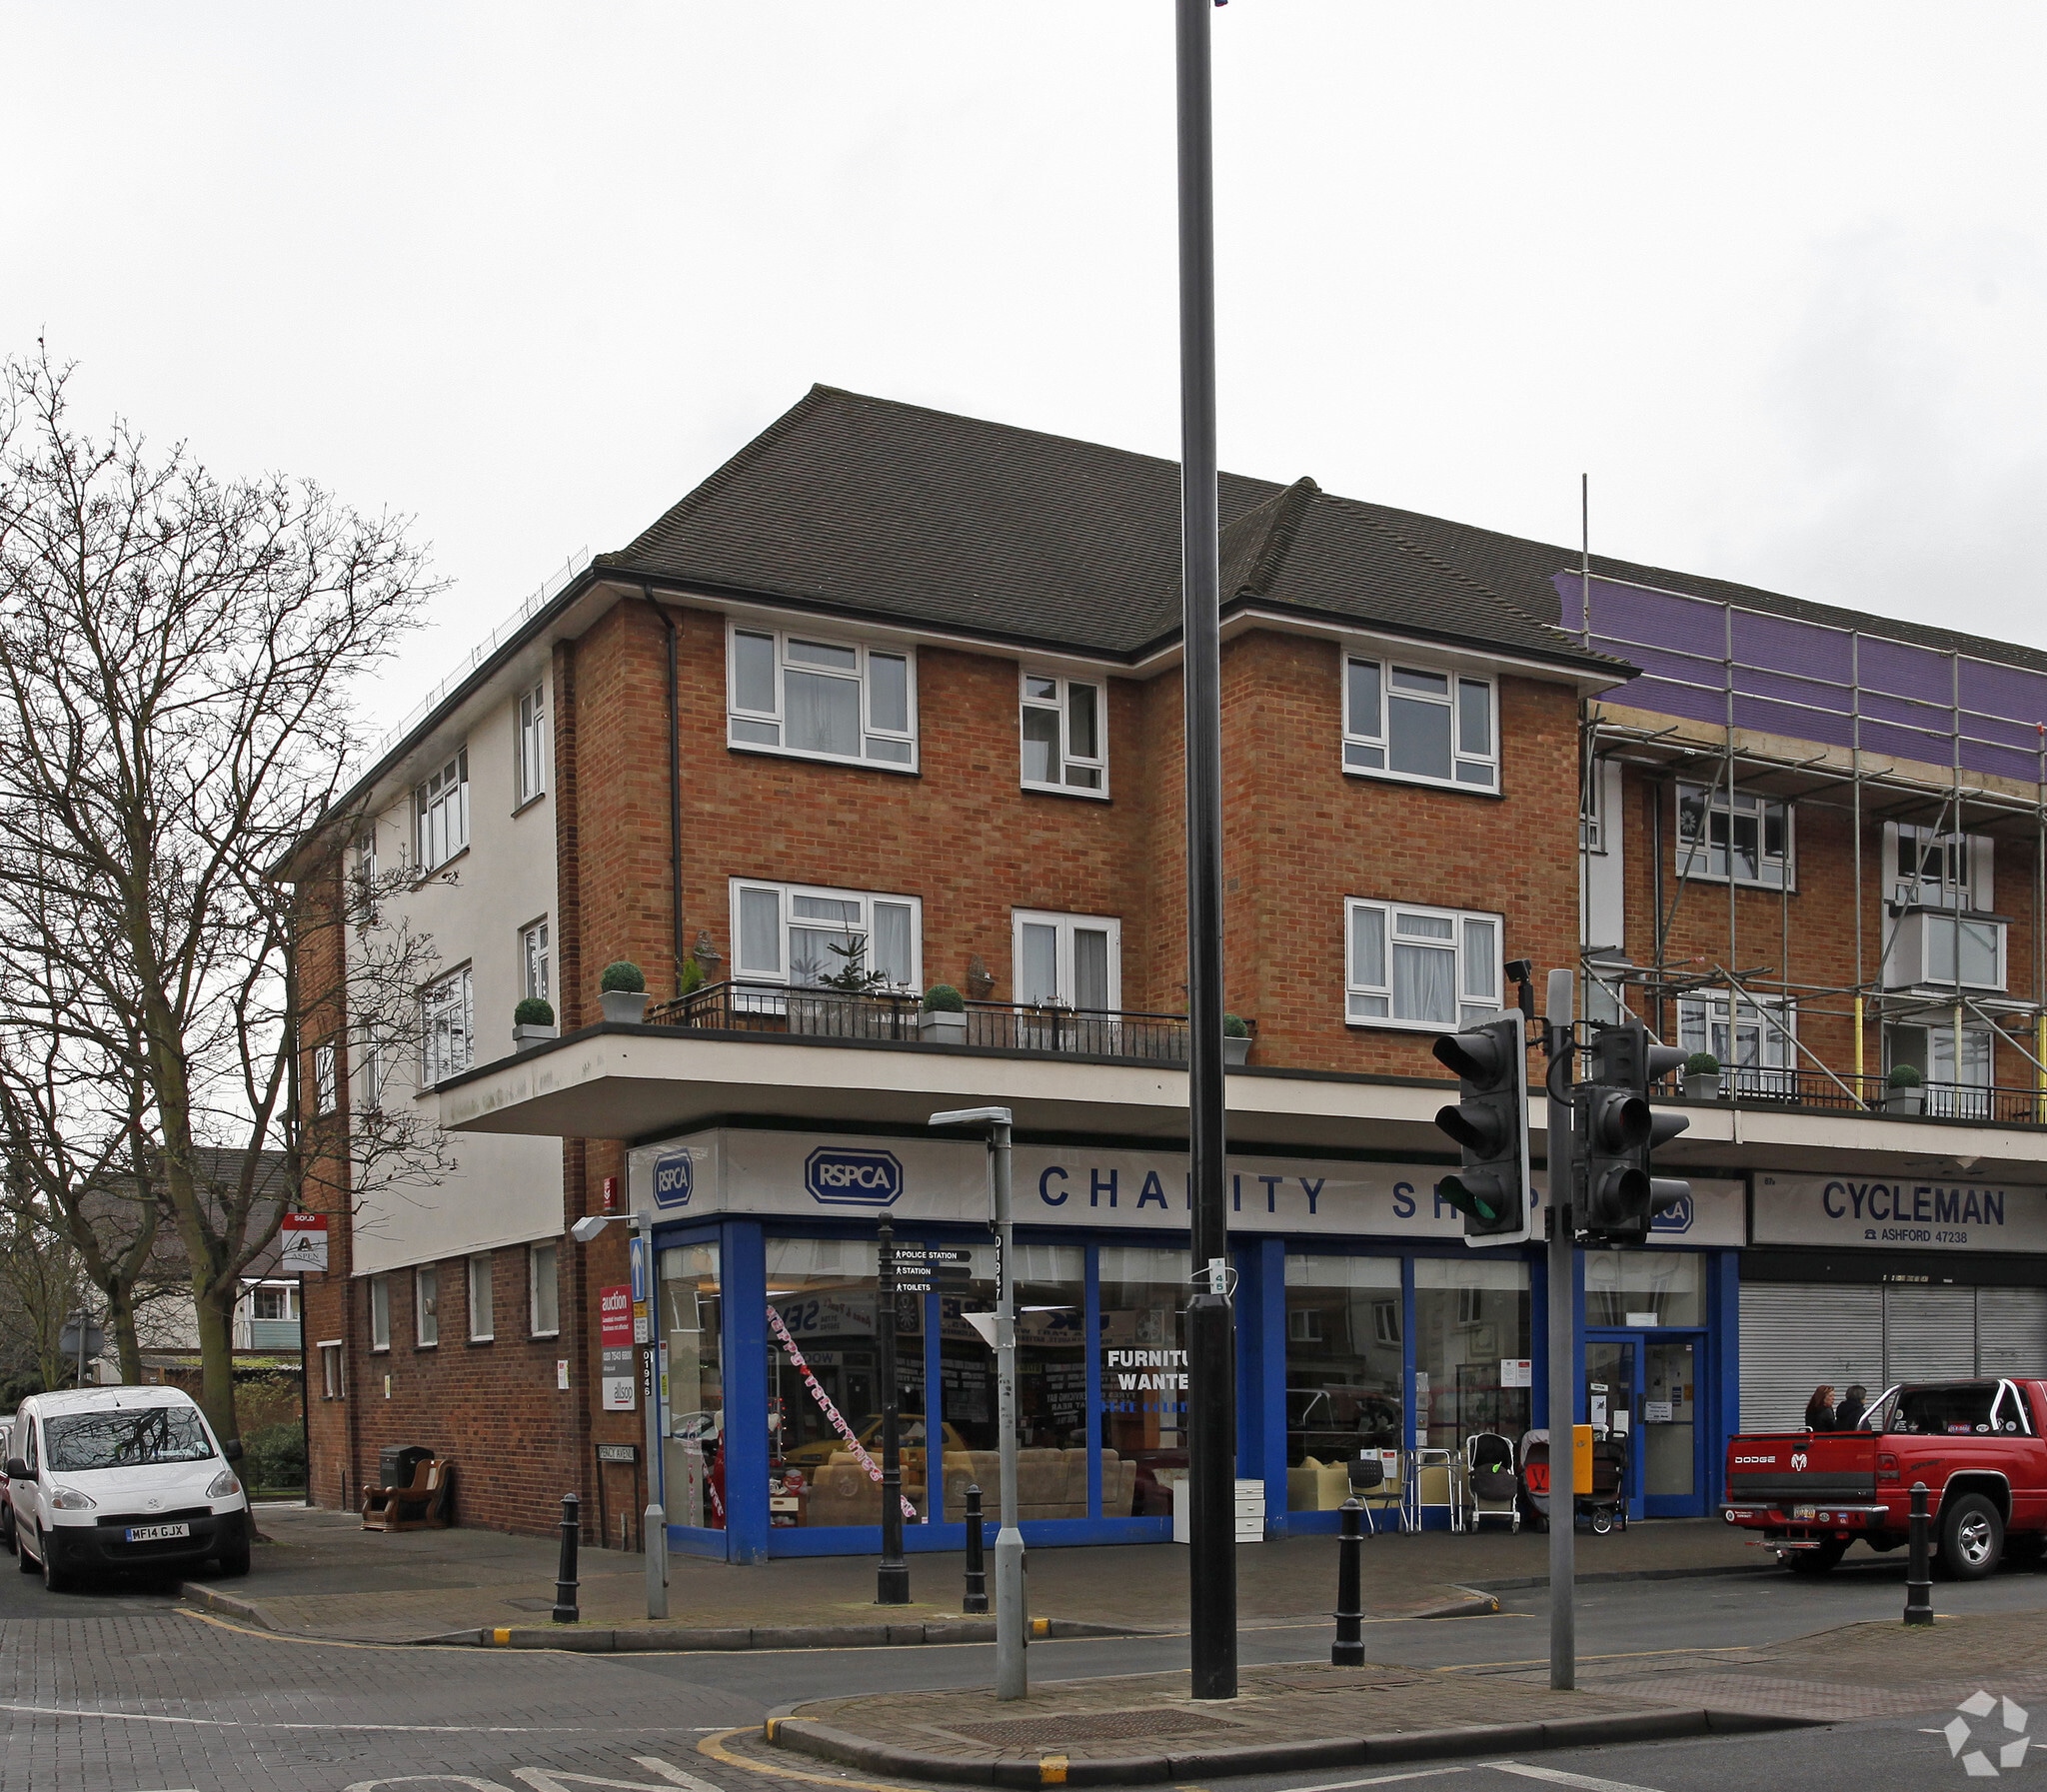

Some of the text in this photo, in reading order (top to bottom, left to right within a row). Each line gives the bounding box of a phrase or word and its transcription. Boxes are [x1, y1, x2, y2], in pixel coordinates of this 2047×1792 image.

[658, 1165, 689, 1192] RSPCA
[820, 1163, 892, 1191] RSPCA
[1038, 1165, 1325, 1215] CHAITY
[1822, 1180, 2005, 1226] CYCLEMAN
[1881, 1228, 1968, 1244] ASHFORD 47238
[929, 1250, 958, 1259] STATION
[602, 1289, 628, 1312] auction
[643, 1350, 652, 1396] 01946
[614, 1381, 634, 1401] allsop
[1735, 1455, 1776, 1464] DODGE
[132, 1525, 184, 1540] MF14 GJX
